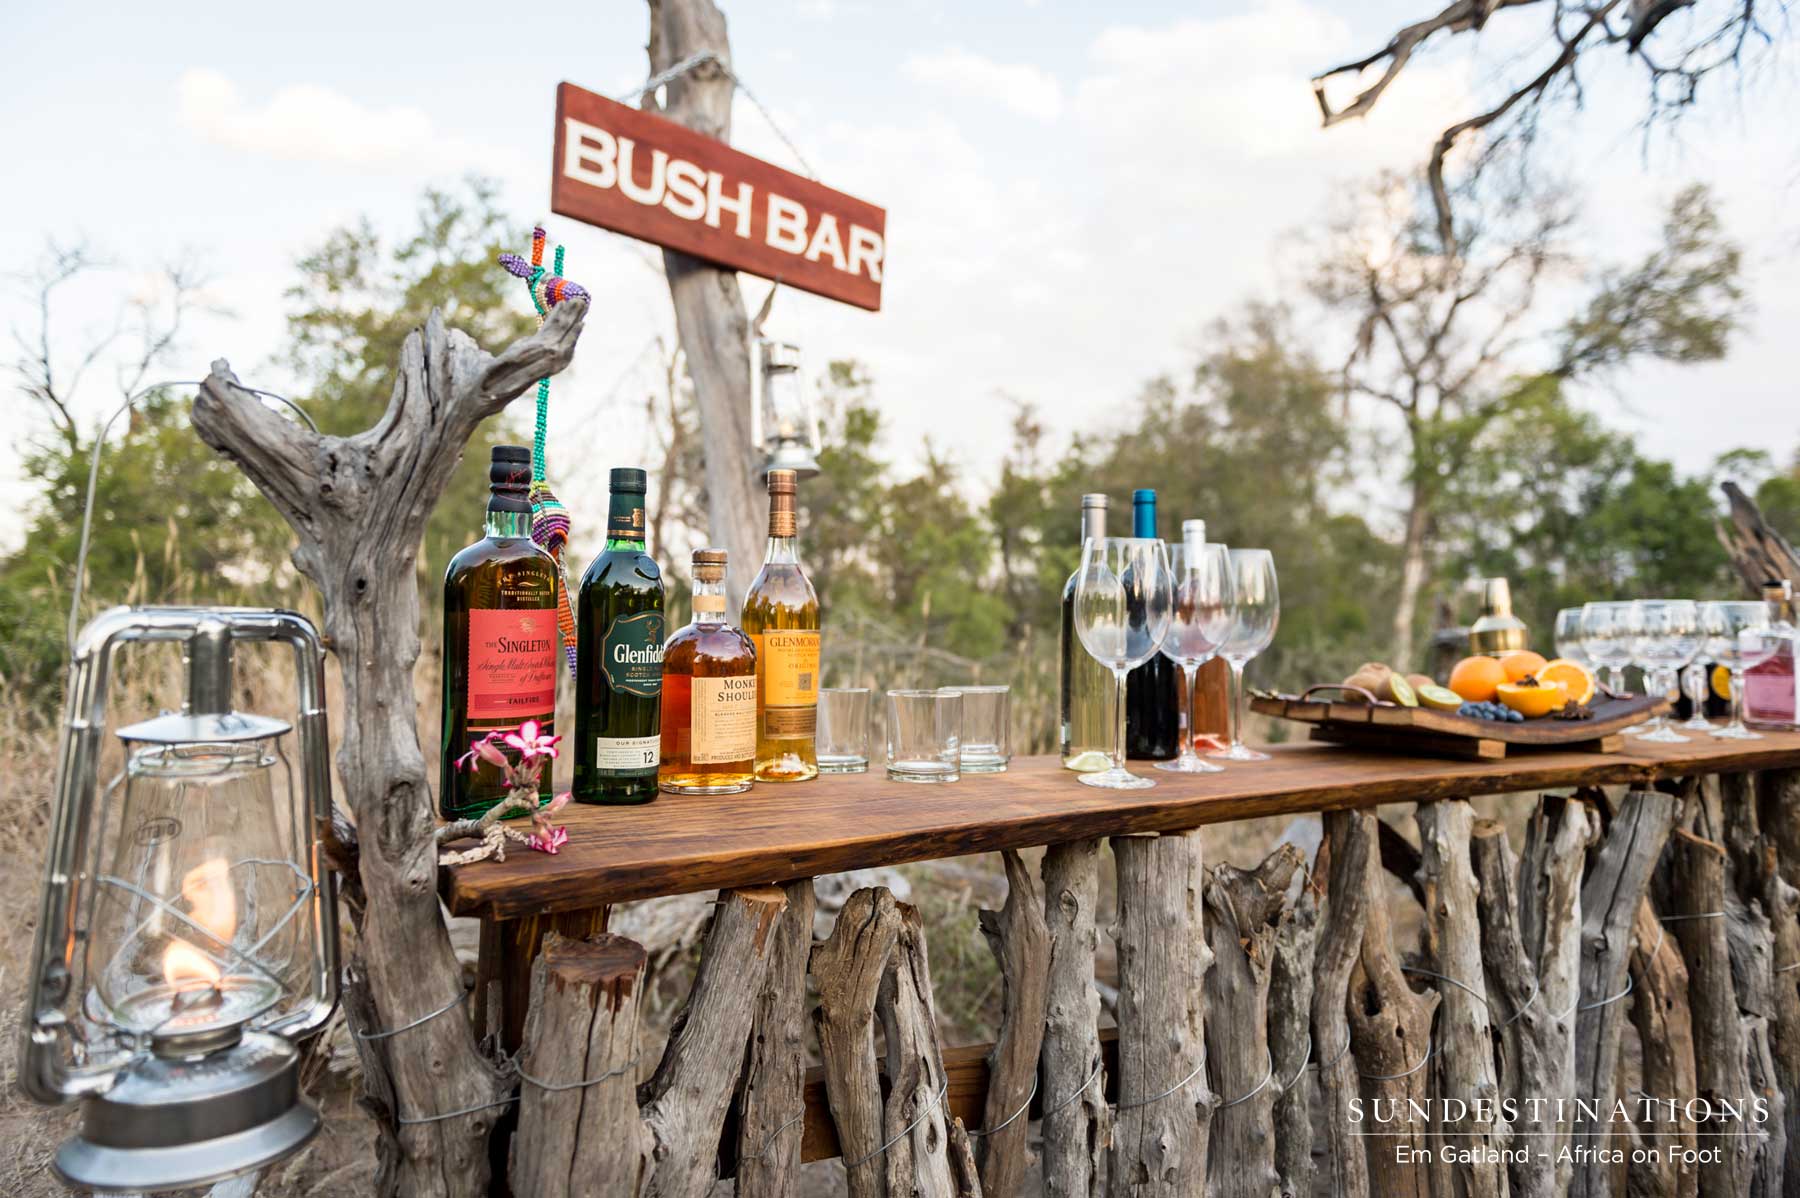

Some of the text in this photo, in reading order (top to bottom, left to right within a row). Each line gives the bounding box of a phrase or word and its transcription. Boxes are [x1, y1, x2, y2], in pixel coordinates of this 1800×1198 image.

[563, 117, 884, 283] BUSH BAR
[485, 636, 551, 654] THE SINGLETON
[643, 751, 654, 764] 12
